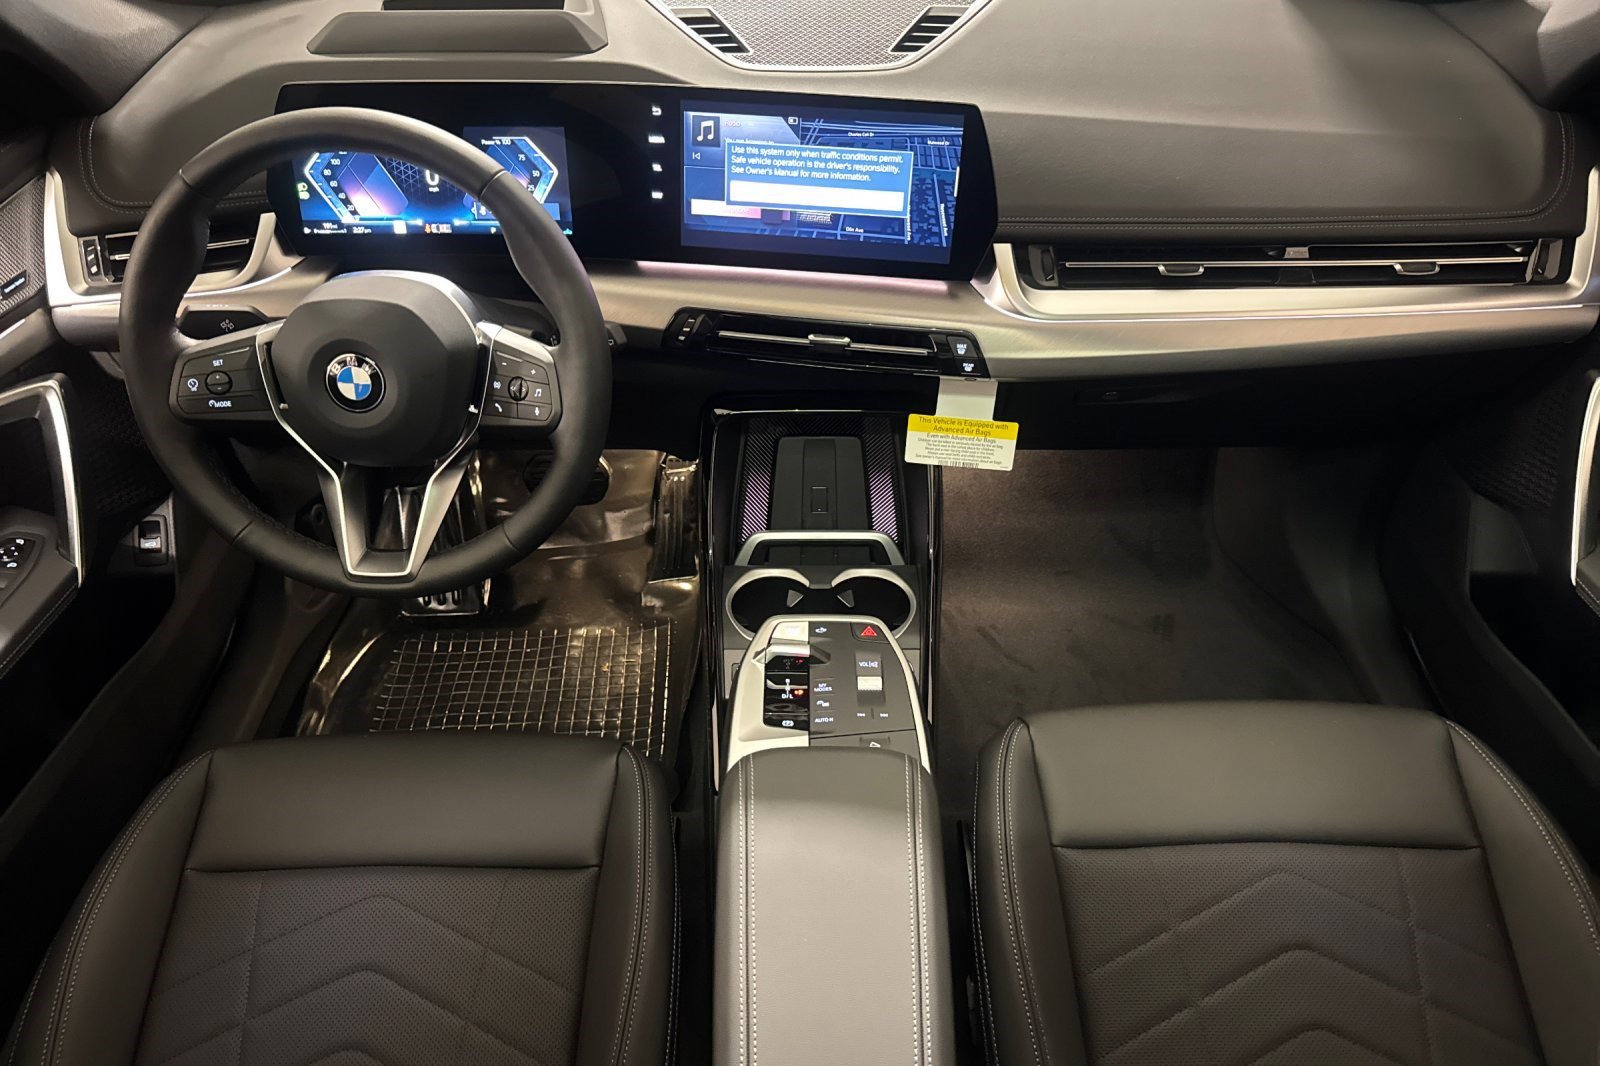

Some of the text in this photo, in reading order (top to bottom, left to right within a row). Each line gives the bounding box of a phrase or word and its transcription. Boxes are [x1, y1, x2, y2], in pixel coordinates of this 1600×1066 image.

[731, 146, 903, 163] Use this system only when traffic conditions permit.
[331, 158, 341, 166] 100
[731, 155, 900, 174] Safe vehicle operation is the driver's responsibility.
[323, 168, 332, 176] 80
[532, 170, 540, 178] 50
[731, 166, 871, 182] See Owner's Manual for more information.
[330, 180, 338, 188] 60
[527, 184, 535, 192] 25
[212, 359, 223, 367] SET
[330, 356, 376, 376] BMW
[215, 400, 232, 408] MODE
[918, 416, 932, 424] This
[933, 417, 956, 426] Vehicle
[964, 419, 994, 429] Equipped
[995, 422, 1009, 430] with
[933, 425, 964, 434] Advanced
[975, 429, 991, 437] Bags
[951, 434, 975, 442] Advanced
[983, 436, 996, 444] Bags
